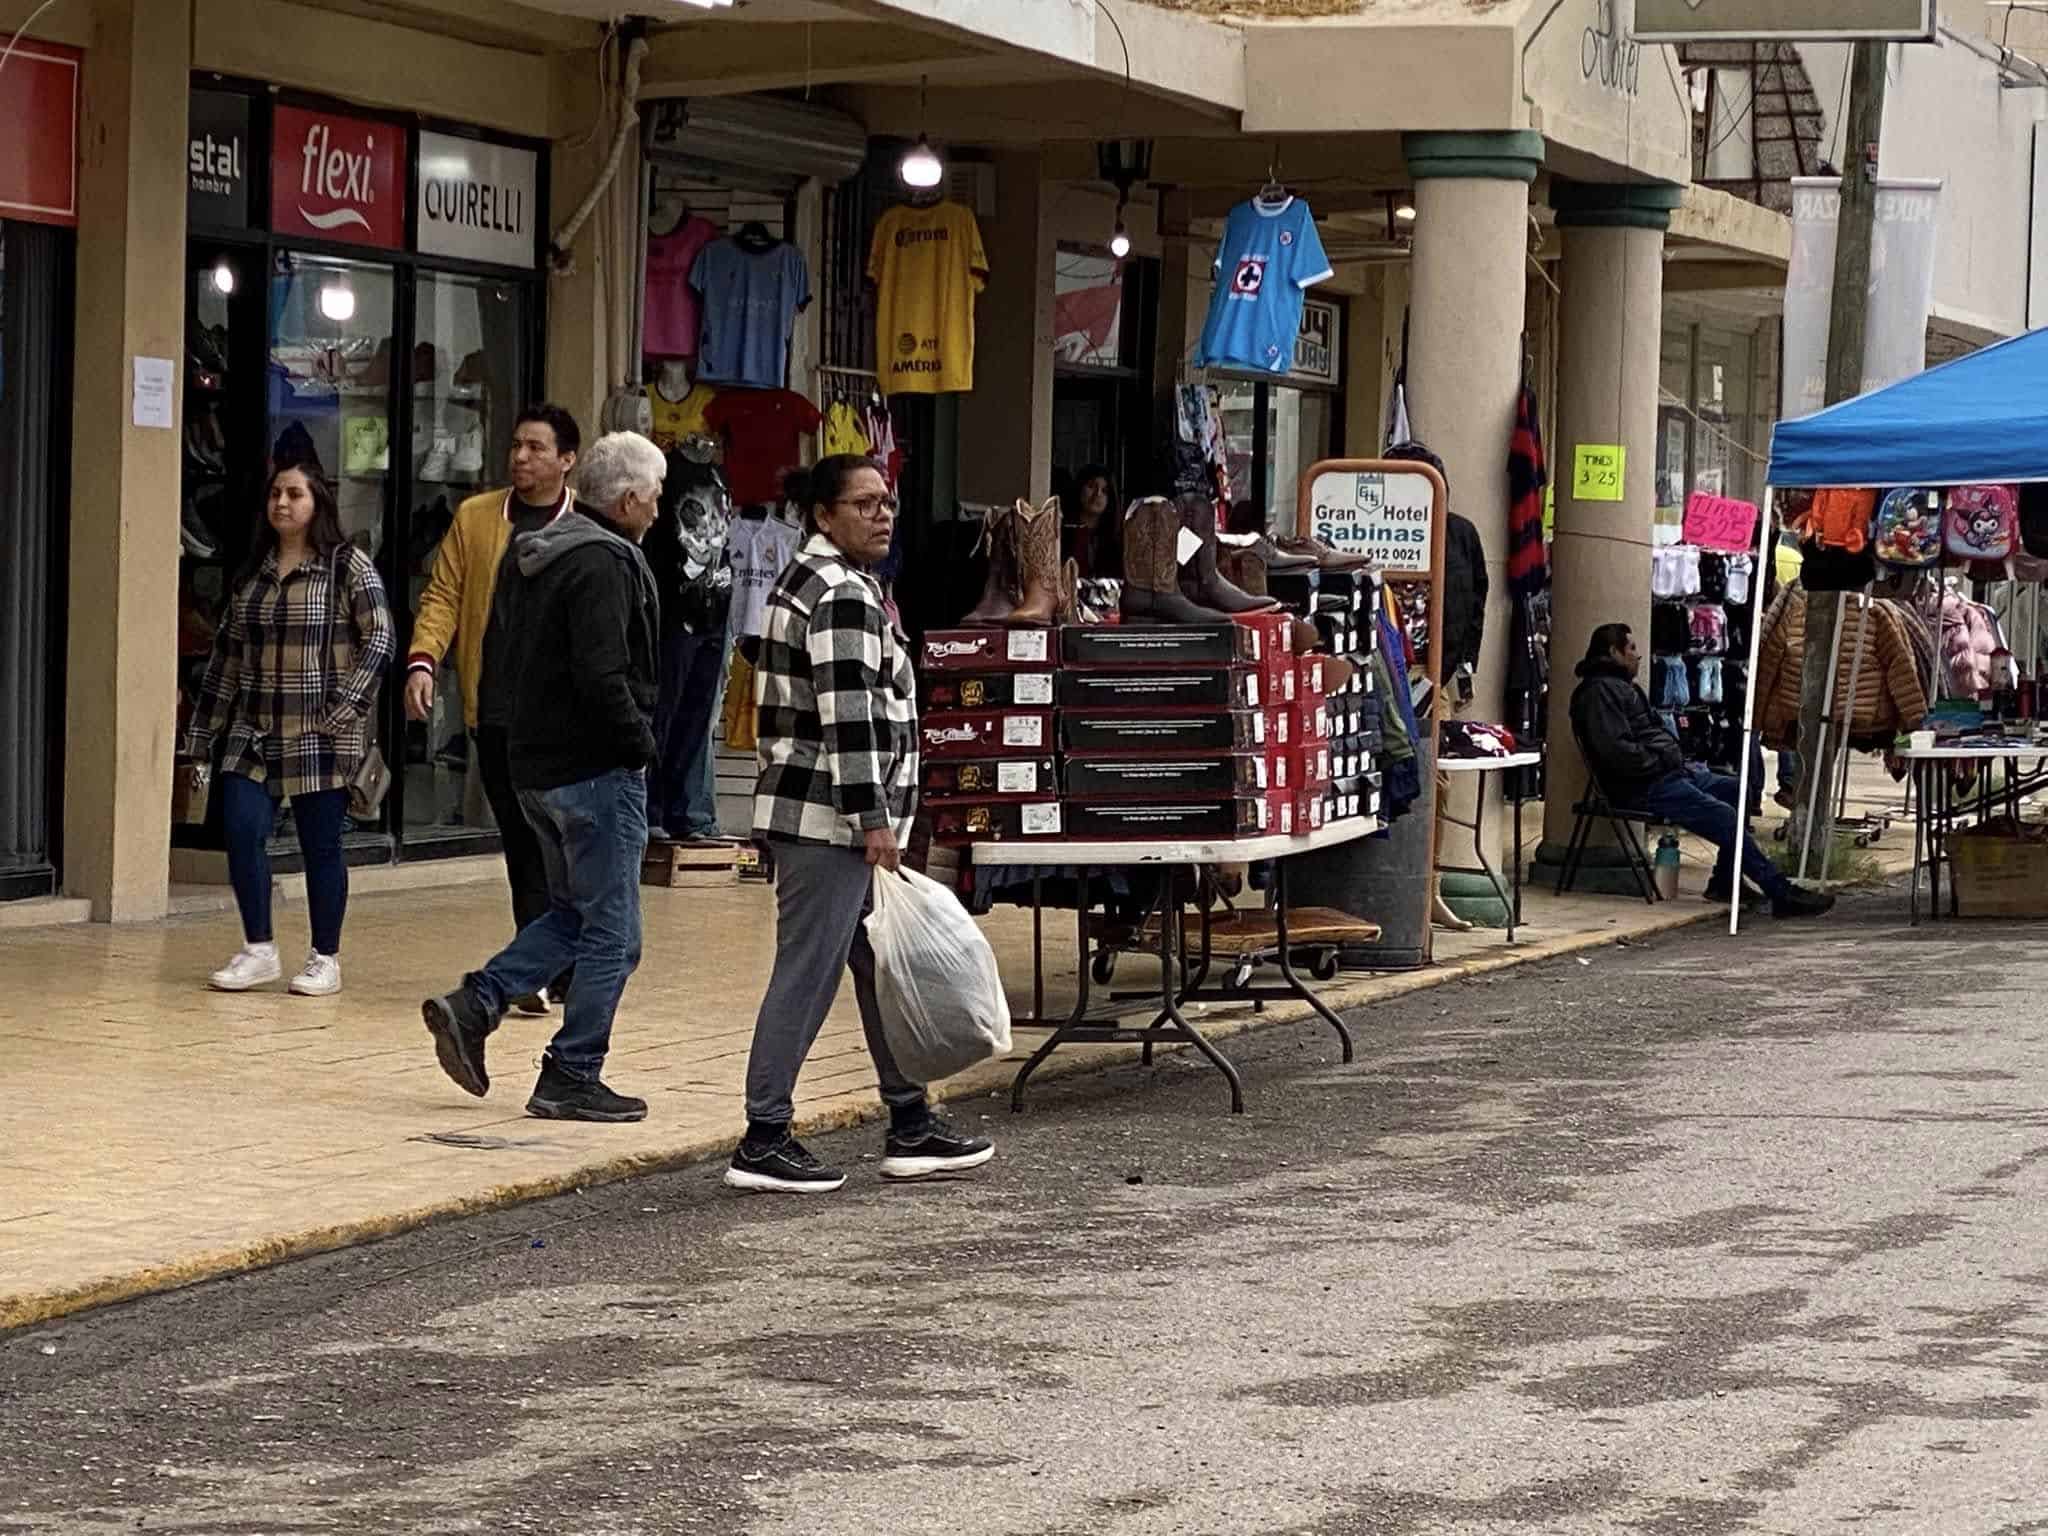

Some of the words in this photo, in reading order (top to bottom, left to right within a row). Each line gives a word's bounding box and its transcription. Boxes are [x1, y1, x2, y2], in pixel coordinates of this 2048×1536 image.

[302, 124, 373, 203] flexi
[1315, 504, 1357, 521] Gran
[1383, 505, 1429, 522] Hotel
[1317, 522, 1425, 543] Sabinas
[1392, 548, 1422, 561] 0021
